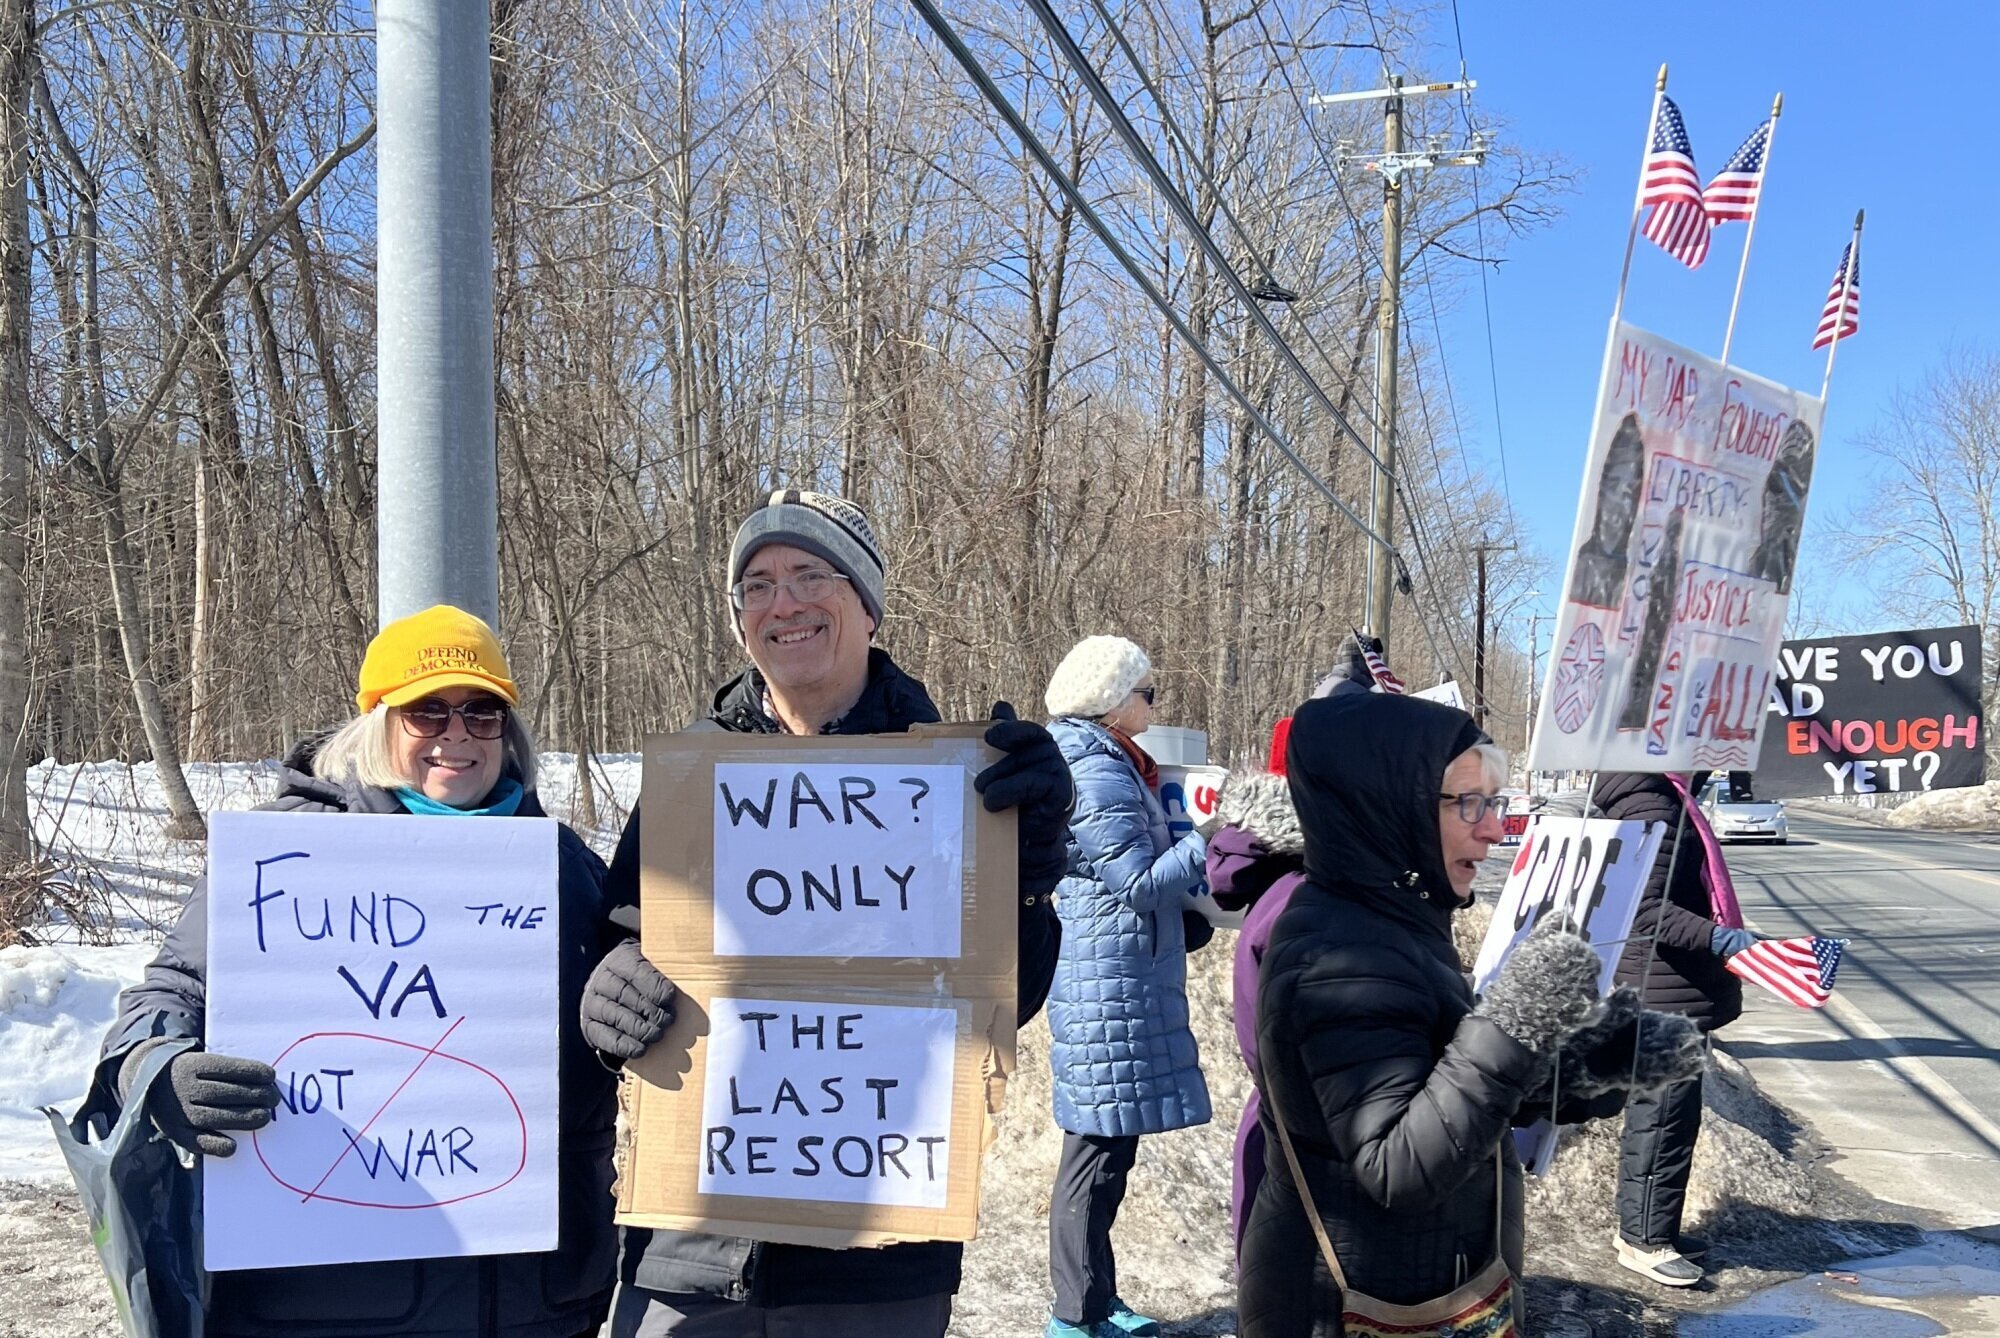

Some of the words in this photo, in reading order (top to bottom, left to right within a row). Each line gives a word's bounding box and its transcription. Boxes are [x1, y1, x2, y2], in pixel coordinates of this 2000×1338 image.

[1615, 339, 1655, 409] MY
[1713, 380, 1788, 462] FOUGHT
[1677, 568, 1755, 628] JUSTICE
[402, 658, 489, 680] DEMOCRAC
[417, 646, 478, 664] DEFEND
[1861, 640, 1964, 682] YOU
[1649, 650, 1682, 747] AND
[1766, 682, 1824, 718] AD
[1787, 714, 1978, 755] ENOUGH
[1823, 750, 1941, 795] YET?
[720, 772, 930, 831] WAR?
[247, 851, 426, 953] FUND
[464, 902, 547, 930] THE
[746, 864, 916, 916] ONLY
[336, 960, 448, 1020] VA
[738, 1011, 864, 1053] THE
[270, 1068, 354, 1121] NOT
[729, 1076, 900, 1121] LAST
[341, 1126, 478, 1182] WAR
[707, 1125, 947, 1181] RESORT
